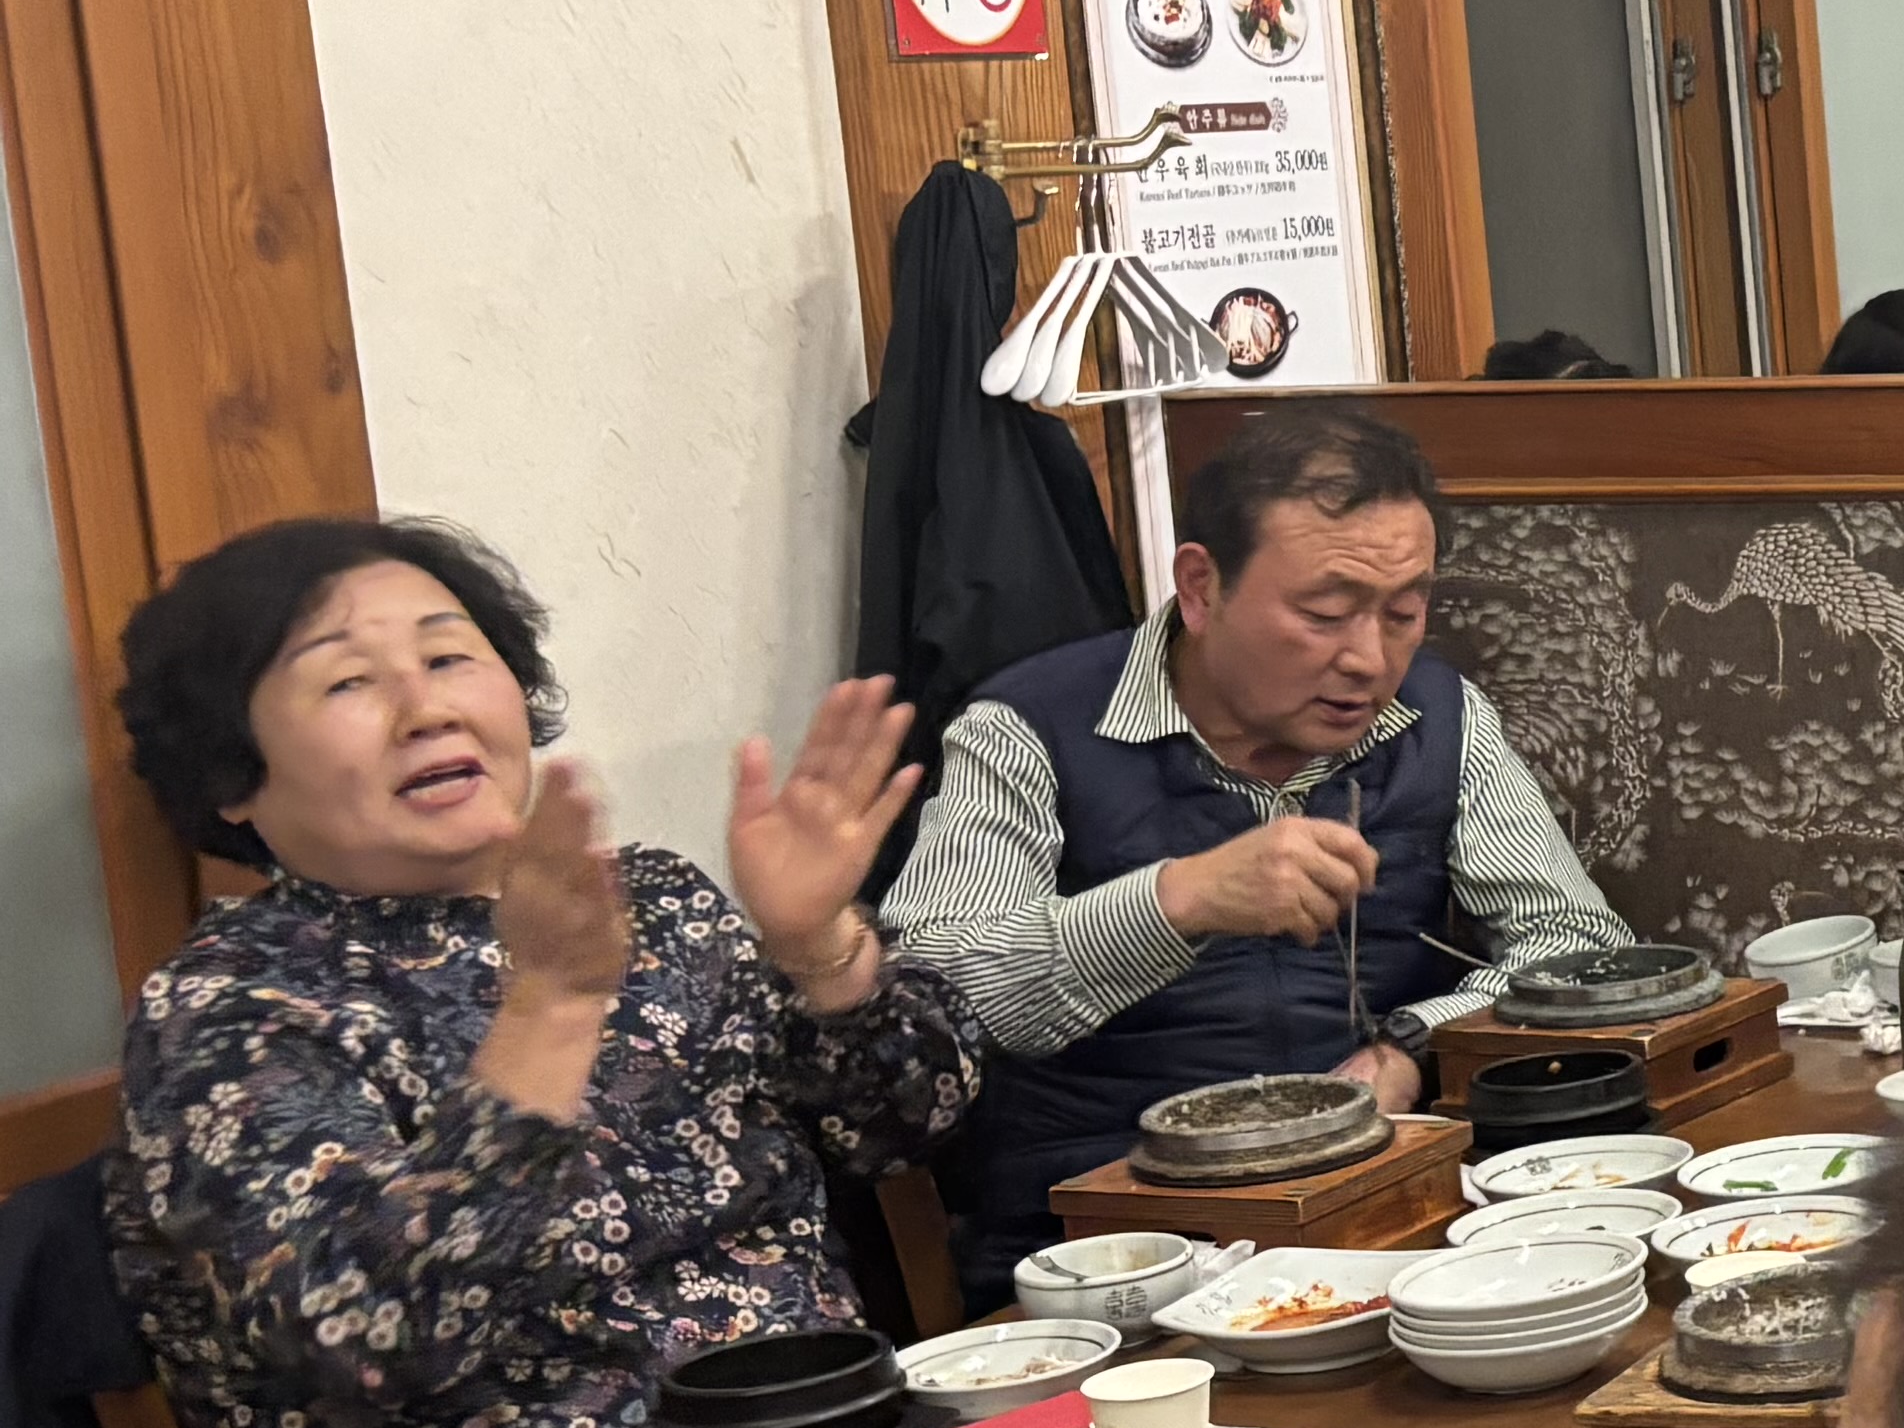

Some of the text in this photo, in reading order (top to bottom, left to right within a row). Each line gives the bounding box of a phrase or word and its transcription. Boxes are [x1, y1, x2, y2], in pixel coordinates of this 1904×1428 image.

[1275, 149, 1328, 175] 35,000원
[1141, 224, 1216, 254] 불고기전골
[1283, 215, 1335, 242] 15,000원
